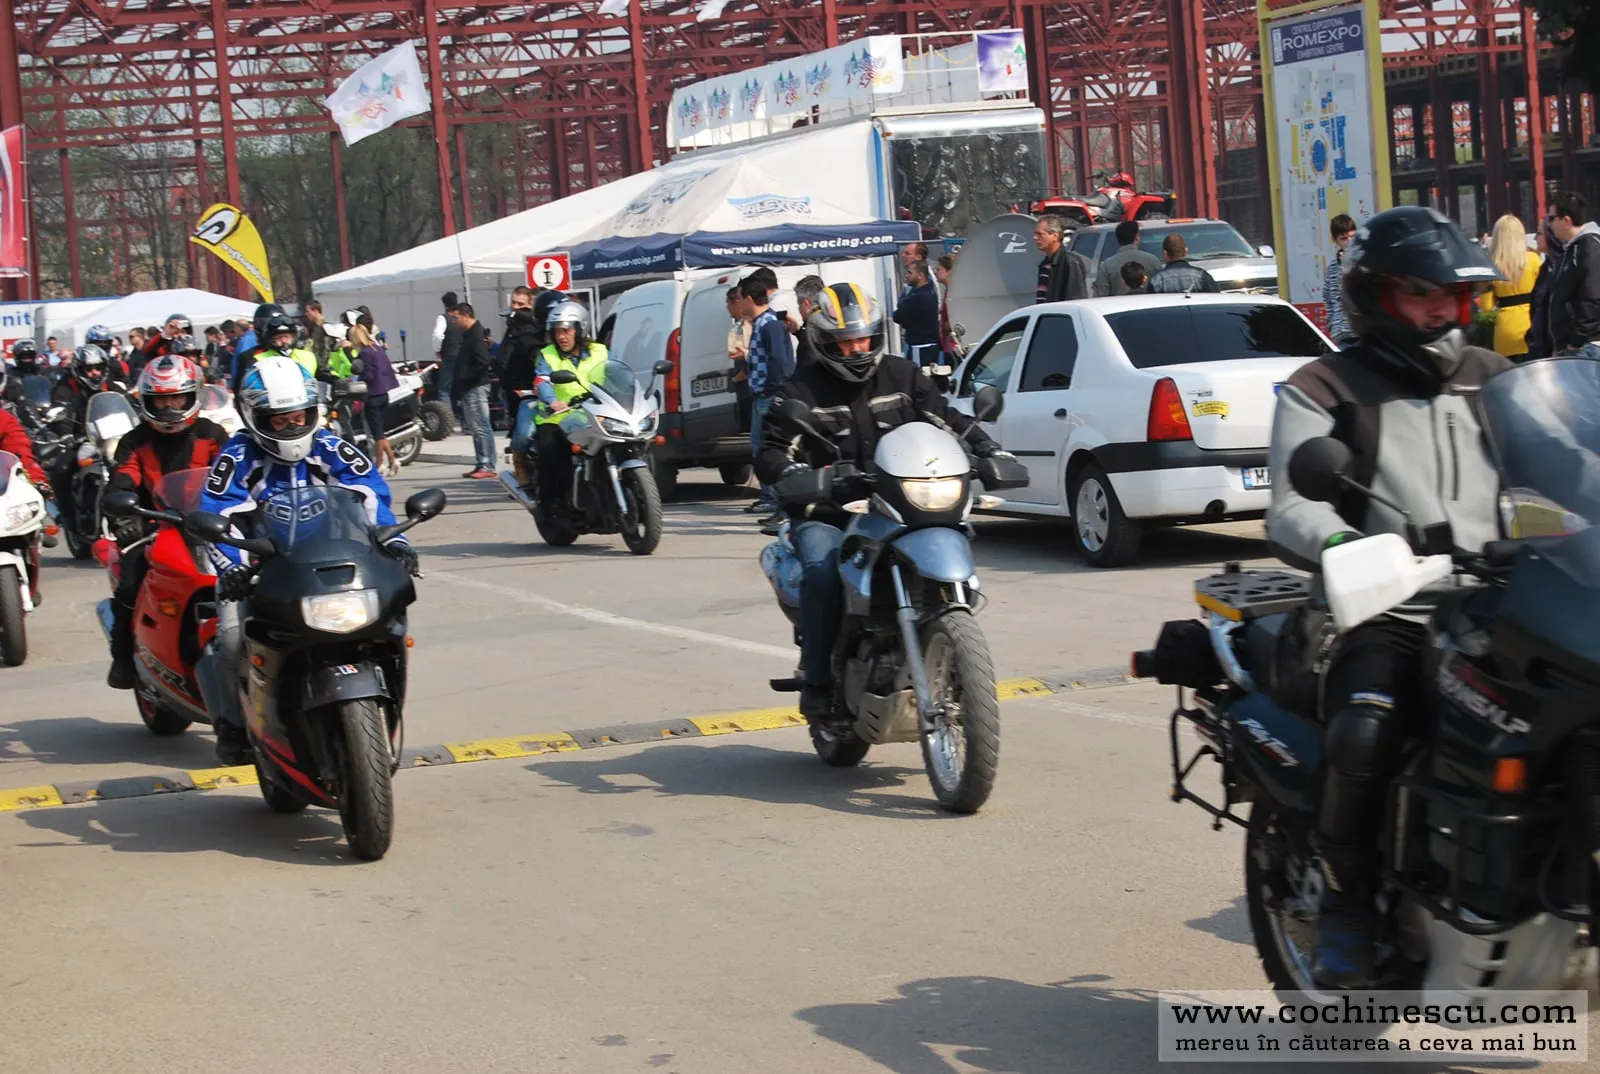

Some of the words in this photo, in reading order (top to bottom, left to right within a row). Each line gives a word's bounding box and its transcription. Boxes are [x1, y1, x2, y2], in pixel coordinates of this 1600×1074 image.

[1282, 24, 1361, 51] ROMEXPO
[711, 234, 893, 256] www.wileyco-racing.com
[336, 440, 373, 476] 9
[205, 453, 235, 496] 9
